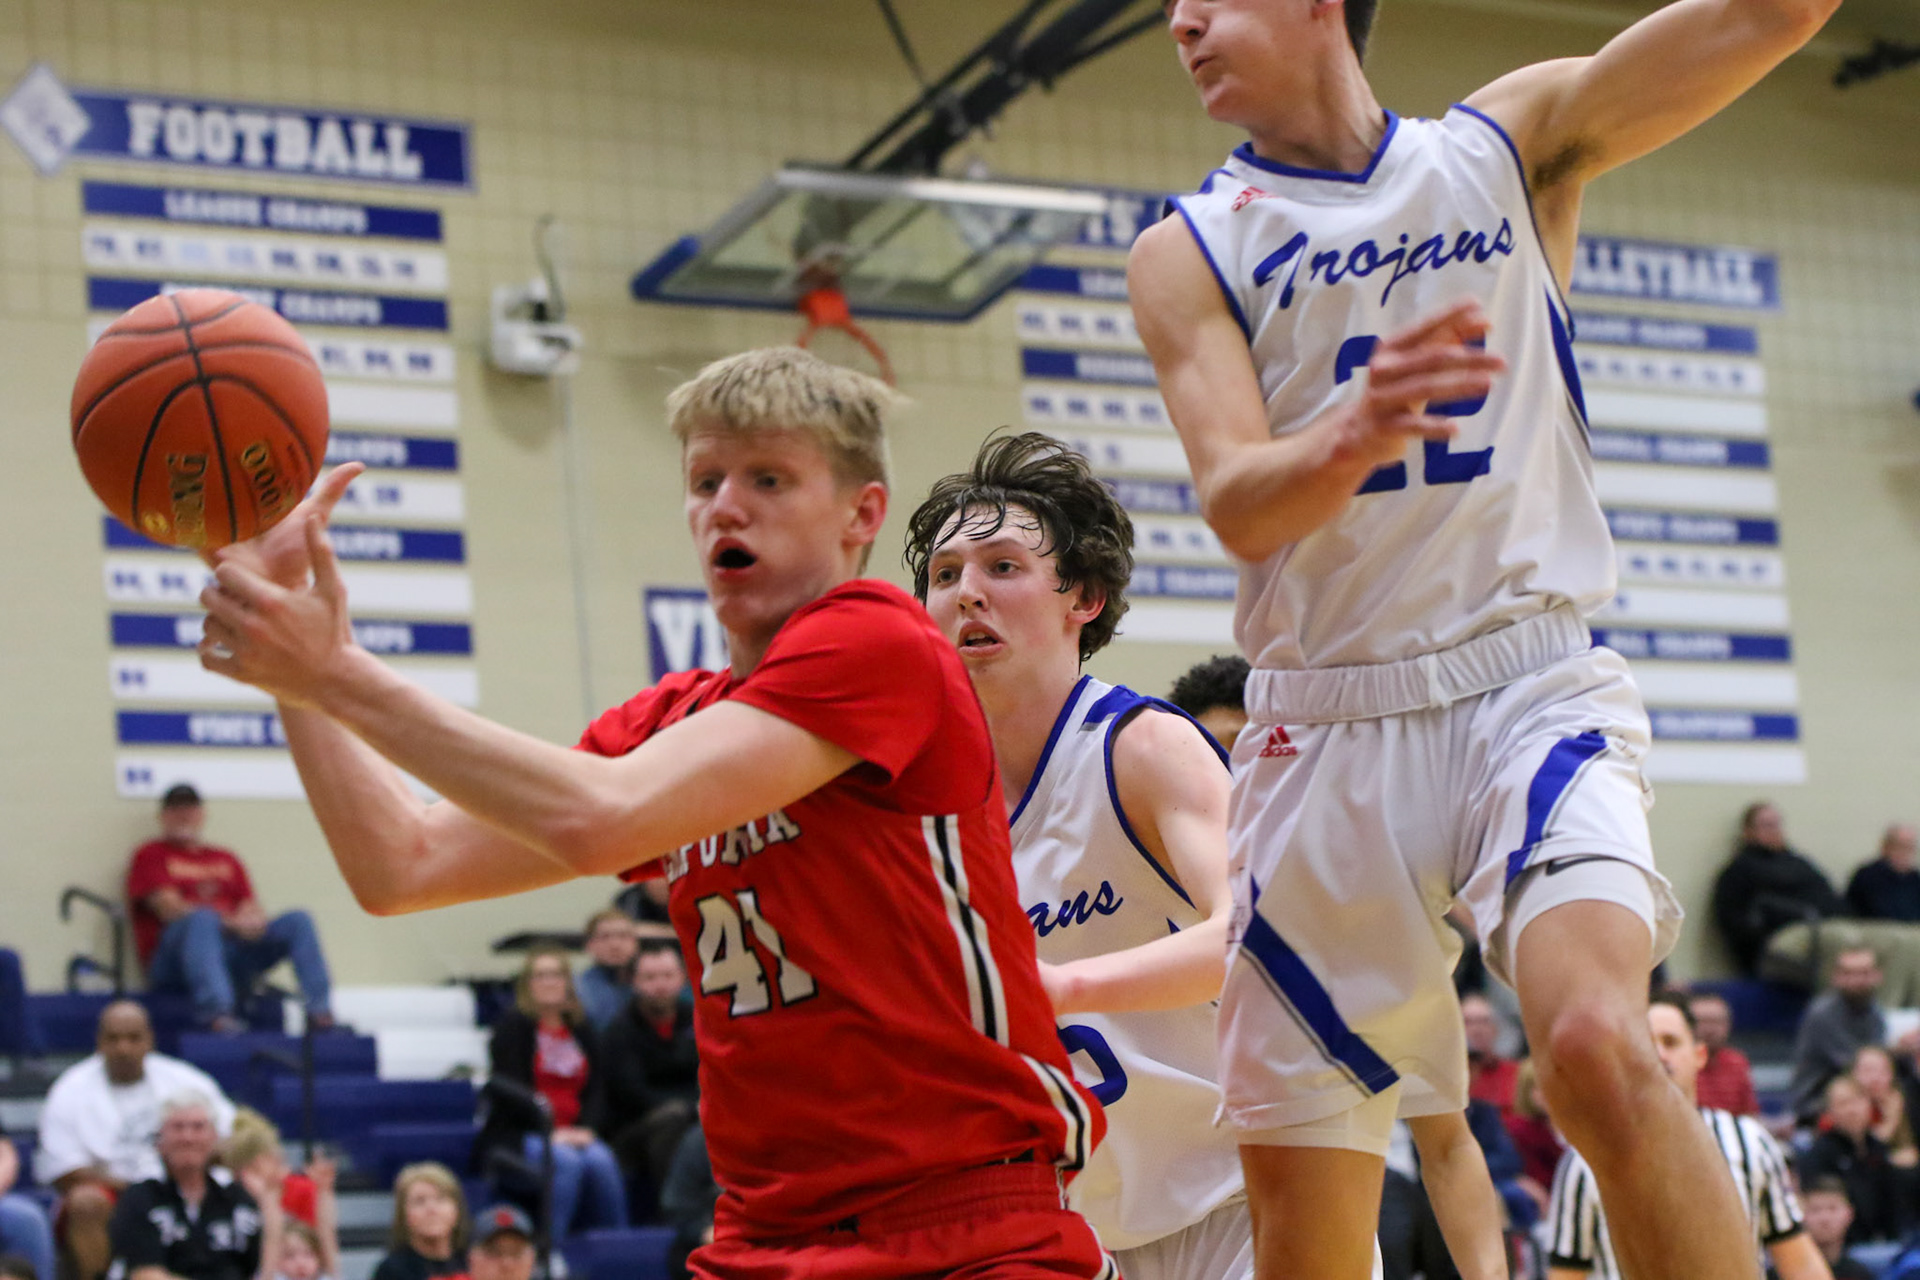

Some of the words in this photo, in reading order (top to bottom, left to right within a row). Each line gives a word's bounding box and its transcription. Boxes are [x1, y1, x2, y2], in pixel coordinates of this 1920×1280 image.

[127, 101, 422, 180] FOOTBALL
[1253, 217, 1515, 310] Trojans
[696, 888, 817, 1016] 41
